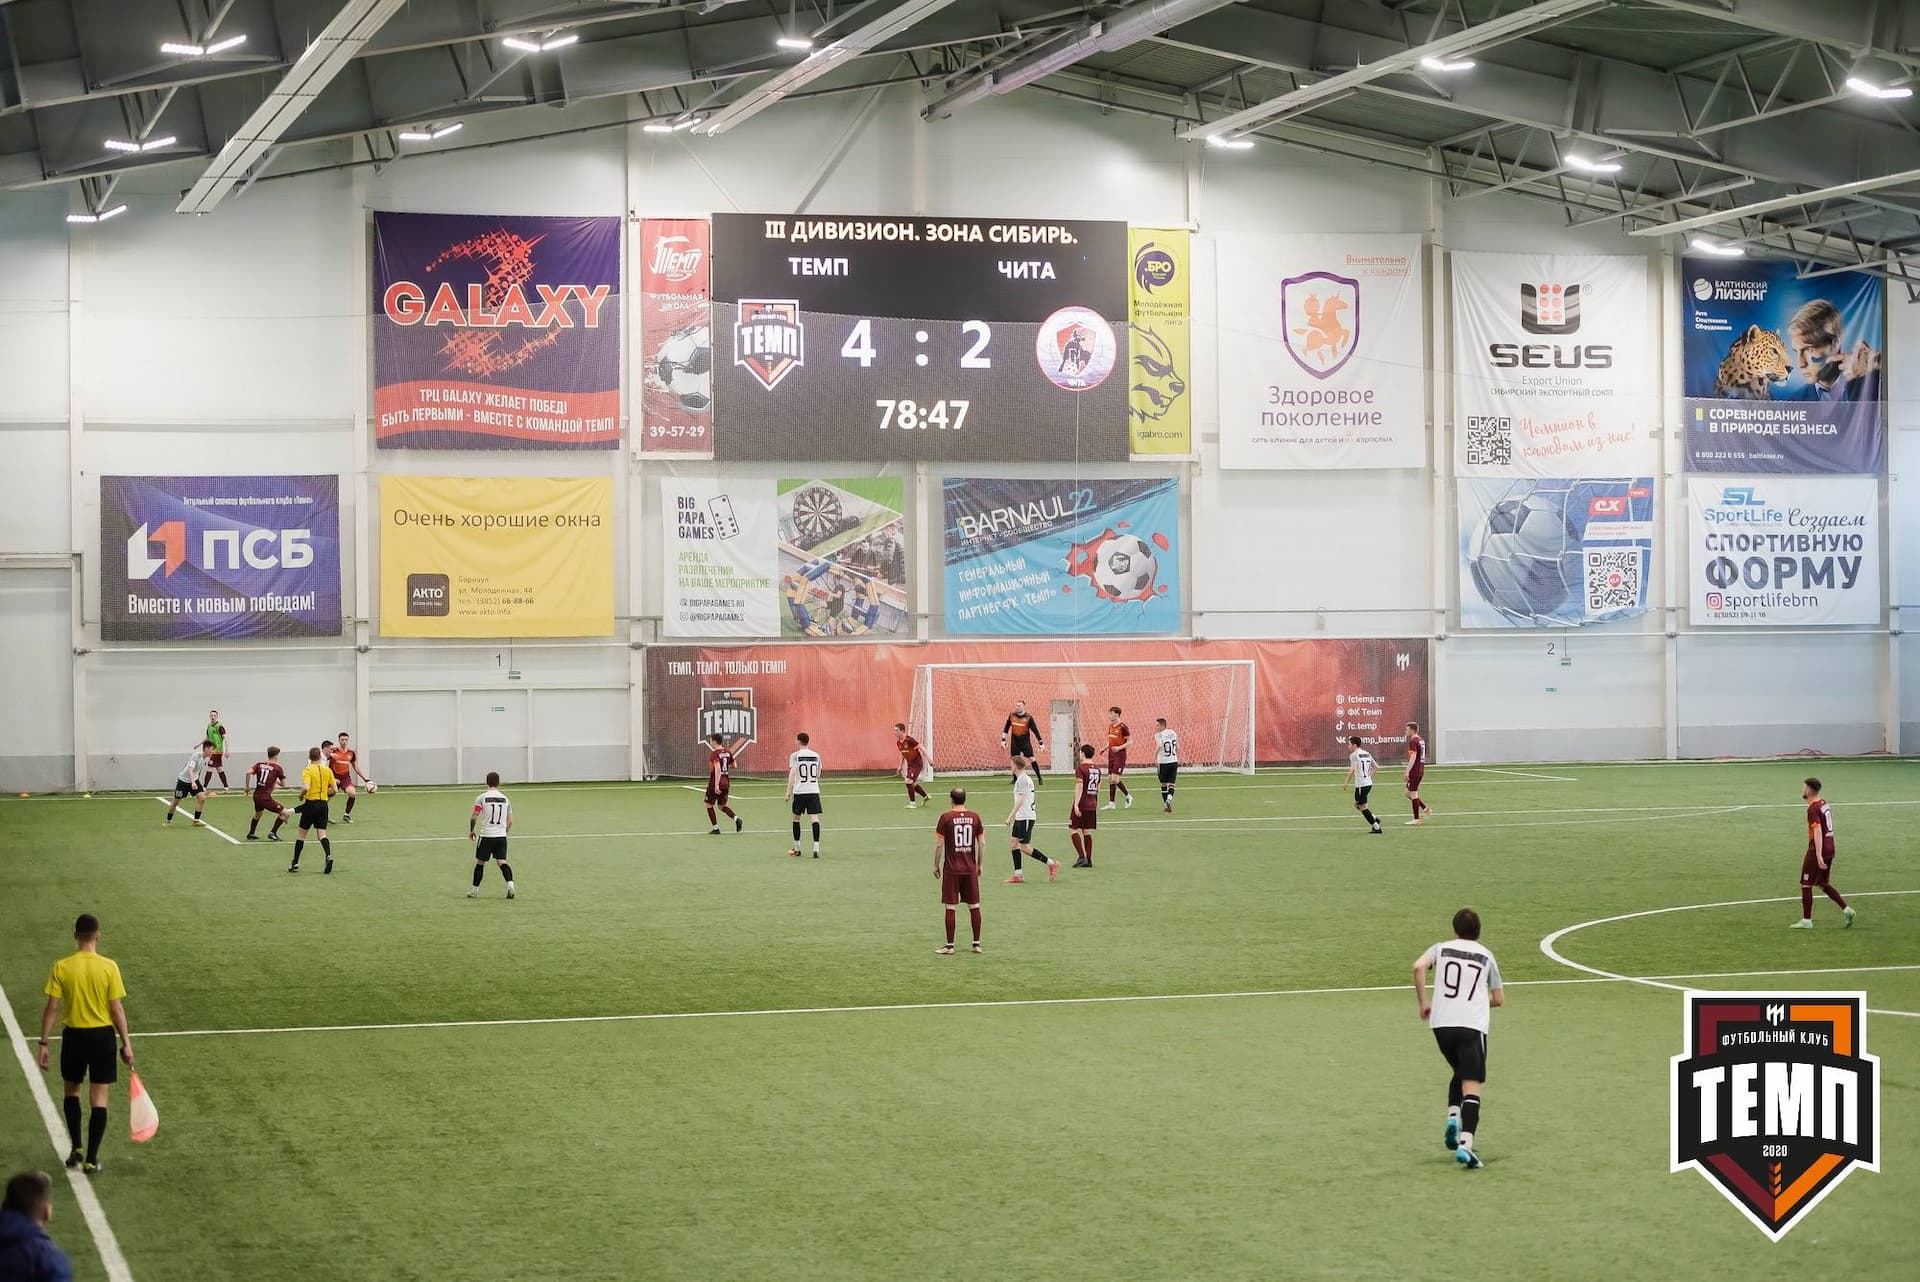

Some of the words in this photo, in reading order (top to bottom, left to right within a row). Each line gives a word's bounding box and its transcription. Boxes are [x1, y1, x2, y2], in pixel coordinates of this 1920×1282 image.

[791, 221, 920, 242] ДИВИЗИОН.
[925, 224, 983, 242] ЗОНА
[988, 225, 1078, 244] СИБИРЬ.
[788, 257, 849, 276] ТЕМП
[997, 260, 1056, 280] ЧИТА
[1714, 280, 1768, 289] БАЛТИЙСКИЙ
[1714, 288, 1767, 301] ЛИЗИНГ
[384, 281, 610, 328] GALAXY
[742, 325, 797, 356] ТЕМП
[841, 319, 876, 367] 4
[960, 320, 991, 368] 2
[1489, 343, 1612, 368] SEUS
[1522, 376, 1552, 386] Export
[1555, 376, 1582, 385] Union
[420, 389, 439, 403] ТРЦ
[443, 390, 481, 403] GALAXY
[485, 393, 527, 409] ЖЕЛАЕТ
[530, 399, 567, 415] ПОБЕД!
[1269, 385, 1374, 406] Здоровое
[382, 409, 410, 427] БЫТЬ
[413, 408, 463, 421] ПЕРВЫМИ
[474, 411, 514, 428] ВМЕСТЕ
[517, 415, 523, 428] С
[526, 417, 583, 434] КОМАНДОЙ
[585, 419, 614, 433] ТЕМП!
[876, 400, 969, 429] 78:47
[1261, 412, 1382, 426] поколение
[1709, 408, 1807, 421] СОРЕВНОВАНИЕ
[650, 426, 705, 436] 39-57-29
[1709, 423, 1718, 433] В
[1721, 423, 1780, 435] ПРИРОДЕ
[1783, 424, 1837, 435] БИЗНЕСА
[678, 497, 695, 509] BIG
[394, 509, 455, 526] Очень
[461, 513, 549, 531] хорошие
[556, 513, 601, 527] окна
[678, 512, 705, 524] PAPA
[1704, 508, 1783, 524] SportLife
[1788, 507, 1865, 532] Создаем
[679, 527, 714, 539] GAMES
[1705, 533, 1863, 552] СПОРТИВНУЮ
[203, 529, 314, 570] ПСБ
[1705, 556, 1862, 589] ФОРМУ
[129, 594, 180, 614] Вместе
[185, 598, 192, 613] к
[197, 598, 245, 612] новым
[250, 591, 315, 613] победам!
[413, 588, 443, 598] АКТО
[1725, 594, 1818, 610] sportlifebrn
[1547, 642, 1555, 654] 2
[496, 653, 501, 667] 1
[668, 661, 694, 676] ТЕМП,
[697, 661, 723, 676] ТЕМП,
[725, 660, 758, 674] ТОЛЬКО
[760, 660, 786, 674] ТЕМП!
[1348, 695, 1384, 704] fctemp.ru
[704, 710, 750, 736] ТЕМП
[1348, 722, 1377, 731] fc.temp
[799, 764, 817, 782] 99
[490, 804, 502, 824] 11
[954, 825, 973, 847] 60
[1444, 961, 1482, 1001] 97
